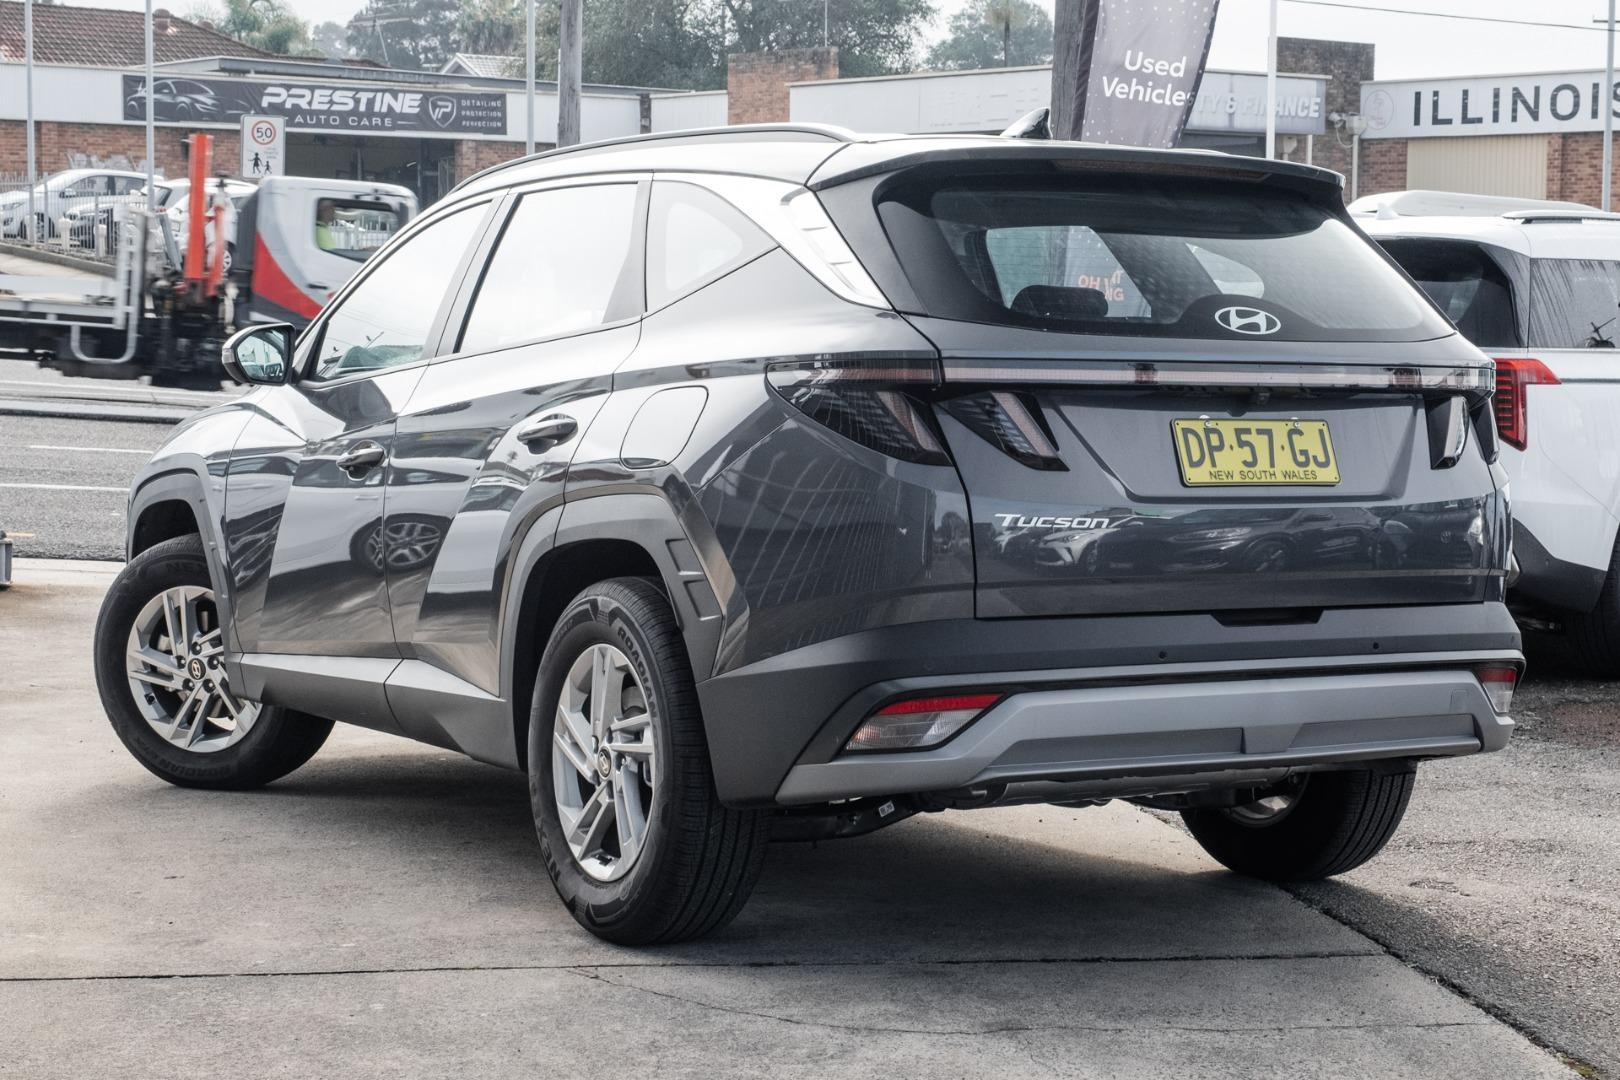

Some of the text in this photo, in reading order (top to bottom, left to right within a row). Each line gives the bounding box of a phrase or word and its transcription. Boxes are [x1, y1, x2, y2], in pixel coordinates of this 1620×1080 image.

[1124, 50, 1187, 78] Used
[261, 86, 423, 114] PRESTINE
[461, 99, 502, 108] DETAILING
[1224, 93, 1237, 114] &
[294, 114, 393, 127] AUTO CARE
[256, 127, 273, 139] 50
[1209, 470, 1318, 481] NEW SOUTH WALES
[617, 626, 658, 719] ROADIAN
